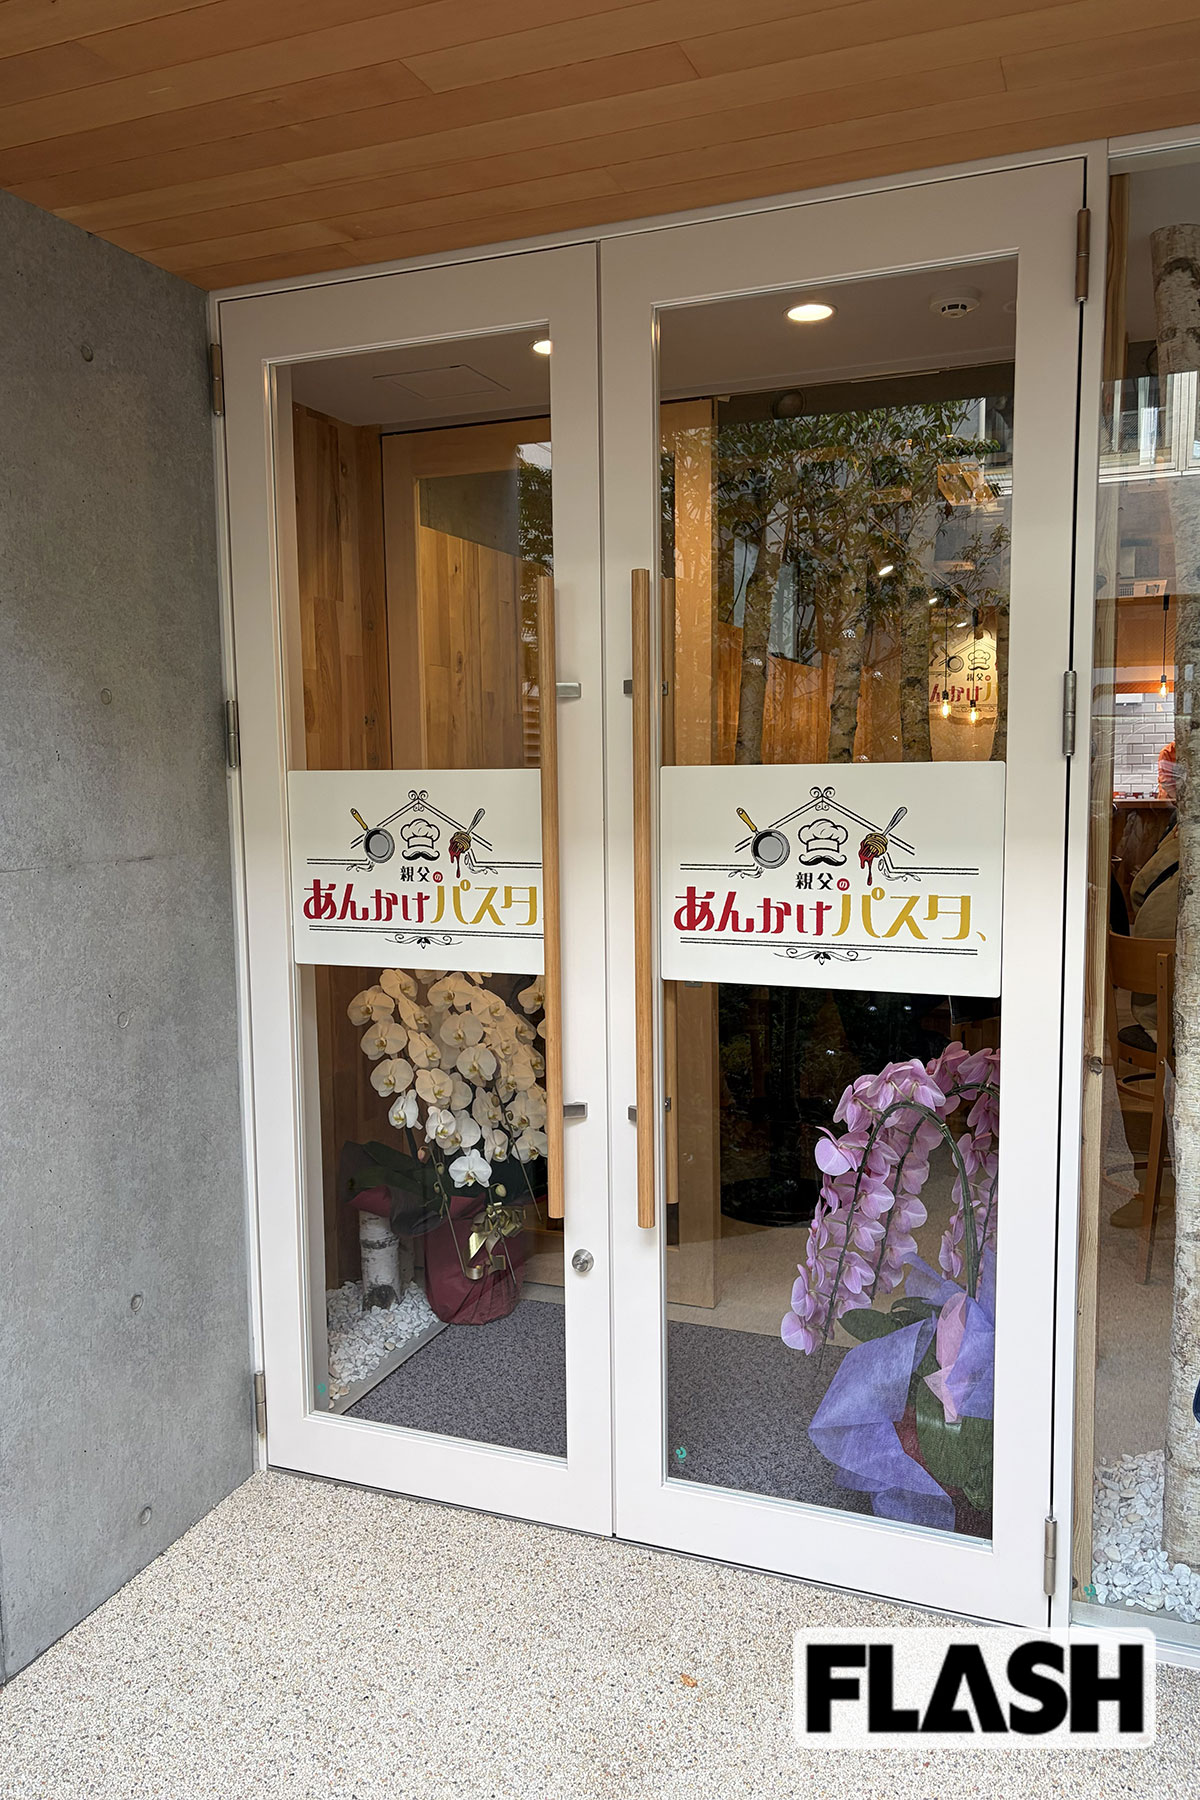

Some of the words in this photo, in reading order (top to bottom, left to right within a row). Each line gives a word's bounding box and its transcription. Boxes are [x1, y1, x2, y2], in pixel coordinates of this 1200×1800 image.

[400, 866, 443, 883] 親父の
[795, 871, 850, 891] 親父の
[303, 879, 537, 926] あんかけパスタ
